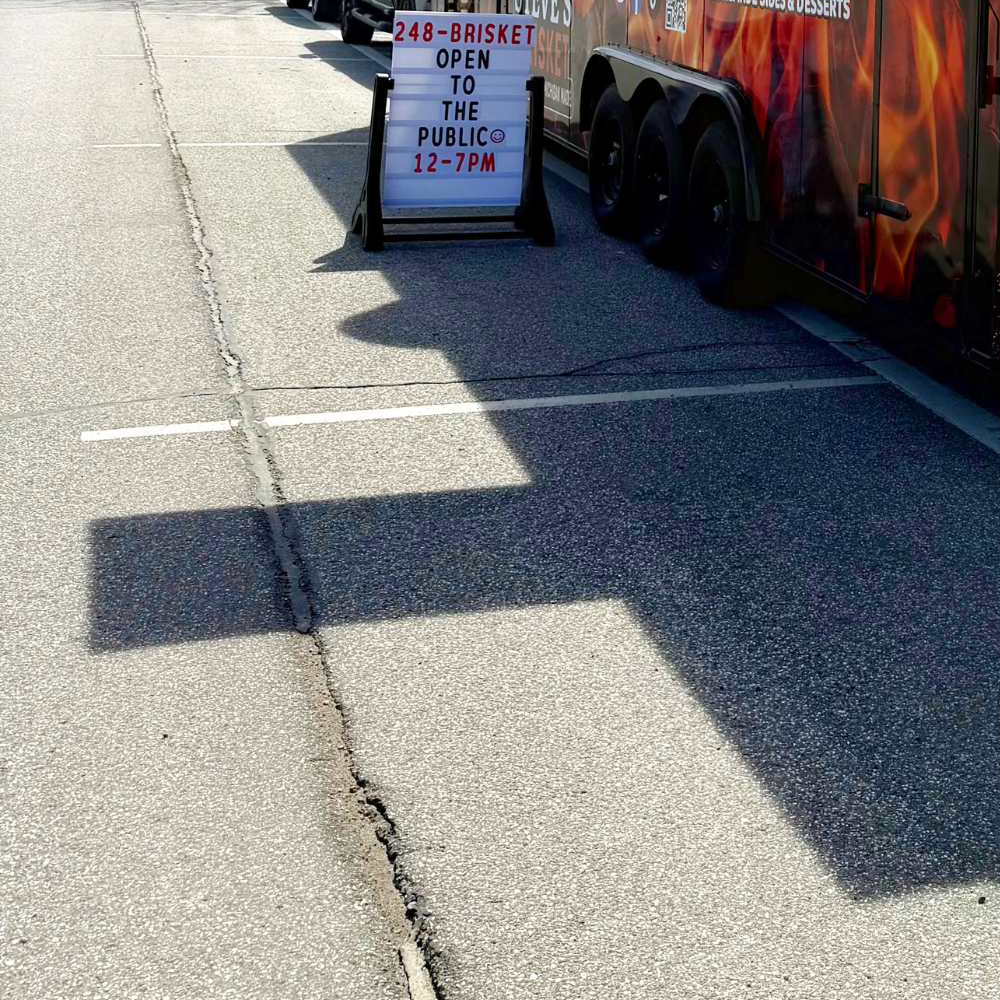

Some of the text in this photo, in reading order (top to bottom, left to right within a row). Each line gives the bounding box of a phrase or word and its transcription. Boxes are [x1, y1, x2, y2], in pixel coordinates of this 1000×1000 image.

[394, 21, 536, 45] 248-BRISKET
[436, 48, 490, 69] OPEN
[450, 75, 475, 95] TO
[442, 101, 479, 121] THE
[418, 126, 488, 147] PUBLIC
[413, 152, 496, 173] 12-7PM
